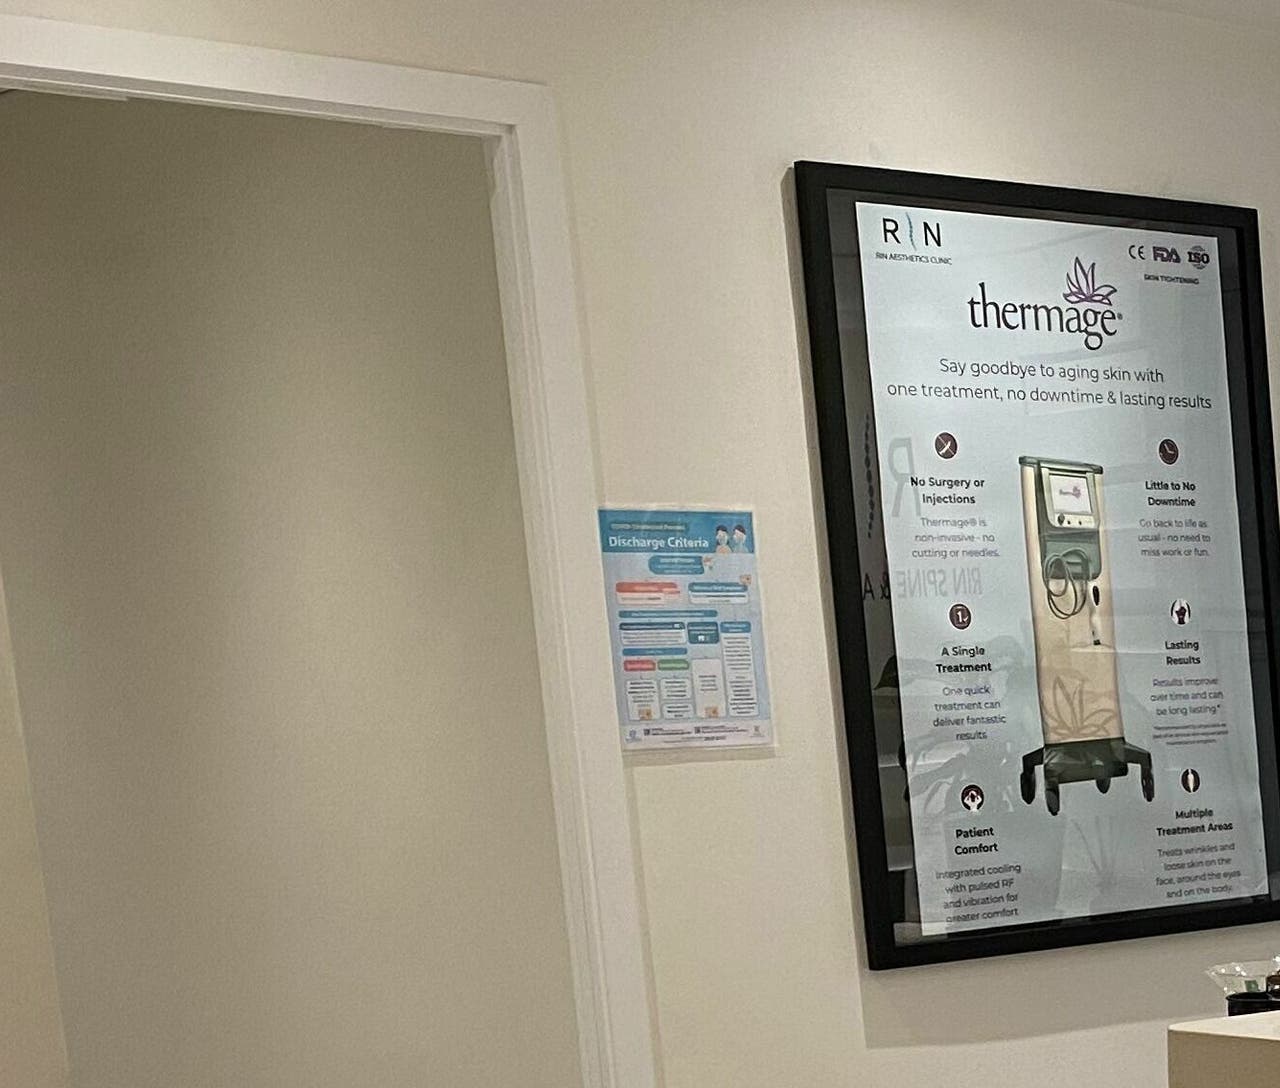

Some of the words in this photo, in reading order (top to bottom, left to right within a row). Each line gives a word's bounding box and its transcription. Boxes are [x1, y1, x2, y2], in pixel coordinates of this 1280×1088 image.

[888, 252, 929, 264] AESTHETICS
[930, 255, 953, 266] CLINIC
[1128, 244, 1146, 261] CE
[1152, 245, 1182, 264] FDA
[1186, 250, 1211, 265] ISO
[939, 357, 967, 377] Say
[970, 360, 1037, 380] goodbye
[1040, 363, 1055, 378] to
[1058, 364, 1099, 383] aging
[1102, 365, 1132, 382] skin
[1134, 366, 1165, 383] with
[886, 383, 918, 397] one
[921, 383, 1004, 403] treatment,
[1007, 388, 1027, 401] no
[1029, 386, 1103, 405] downtime
[1107, 390, 1117, 406] &
[1119, 390, 1166, 411] lasting
[1168, 393, 1213, 410] results
[910, 475, 926, 487] No
[928, 476, 971, 490] Surgery
[973, 478, 985, 488] or
[1145, 480, 1169, 492] Little
[1170, 481, 1181, 491] to
[1181, 481, 1197, 492] No
[922, 493, 976, 506] Injections
[1147, 496, 1197, 507] Downtime
[1138, 518, 1152, 529] Go
[1153, 518, 1174, 528] back
[1173, 518, 1184, 529] to
[1184, 518, 1197, 529] life
[1197, 520, 1208, 529] as
[608, 535, 666, 551] Discharge
[667, 536, 710, 548] Criteria
[982, 534, 995, 543] no
[1137, 532, 1162, 543] usual
[1166, 534, 1179, 543] no
[1179, 533, 1201, 543] need
[1201, 533, 1212, 543] to
[911, 548, 948, 560] cutting
[950, 549, 960, 558] or
[961, 548, 1001, 559] needles.
[1140, 548, 1161, 557] miss
[1161, 547, 1183, 557] work
[1183, 548, 1193, 557] or
[940, 646, 950, 657] A
[952, 644, 986, 659] Single
[1164, 639, 1200, 652] Lasting
[1166, 655, 1201, 666] Results
[935, 662, 993, 674] Treatment
[1152, 677, 1184, 688] Results
[1184, 677, 1219, 687] improve
[942, 686, 963, 697] One
[964, 684, 991, 699] quick
[1149, 693, 1169, 703] over
[1169, 692, 1190, 702] time
[1190, 690, 1207, 701] and
[1208, 691, 1224, 701] can
[933, 701, 983, 712] treatment
[983, 701, 1001, 710] can
[1155, 706, 1167, 716] be
[1168, 704, 1188, 717] long
[932, 716, 965, 728] deliver
[966, 714, 1007, 726] fantastic
[955, 730, 988, 742] results
[1175, 808, 1214, 820] Multiple
[955, 826, 995, 840] Patient
[1156, 823, 1206, 837] Treatment
[1207, 821, 1234, 833] Areas
[954, 841, 999, 856] Comfort
[1157, 847, 1183, 858] Treats
[1183, 844, 1218, 856] wrinkles
[1219, 842, 1236, 852] and
[1163, 862, 1186, 872] loose
[1186, 859, 1205, 870] skin
[1204, 859, 1217, 868] on
[1217, 856, 1232, 867] the
[935, 865, 986, 881] Integrated
[986, 862, 1022, 875] cooling
[1155, 876, 1176, 887] face,
[1177, 872, 1207, 885] around
[1207, 871, 1222, 881] the
[1222, 869, 1242, 881] eyes
[944, 883, 967, 895] with
[968, 878, 1000, 894] pulsed
[1001, 878, 1015, 888] RF
[1166, 888, 1183, 899] and
[1183, 887, 1195, 897] on
[1196, 885, 1211, 896] the
[943, 898, 962, 910] and
[962, 893, 1005, 909] vibration
[1005, 892, 1019, 903] for
[945, 912, 981, 924] greater
[981, 906, 1020, 920] comfort
